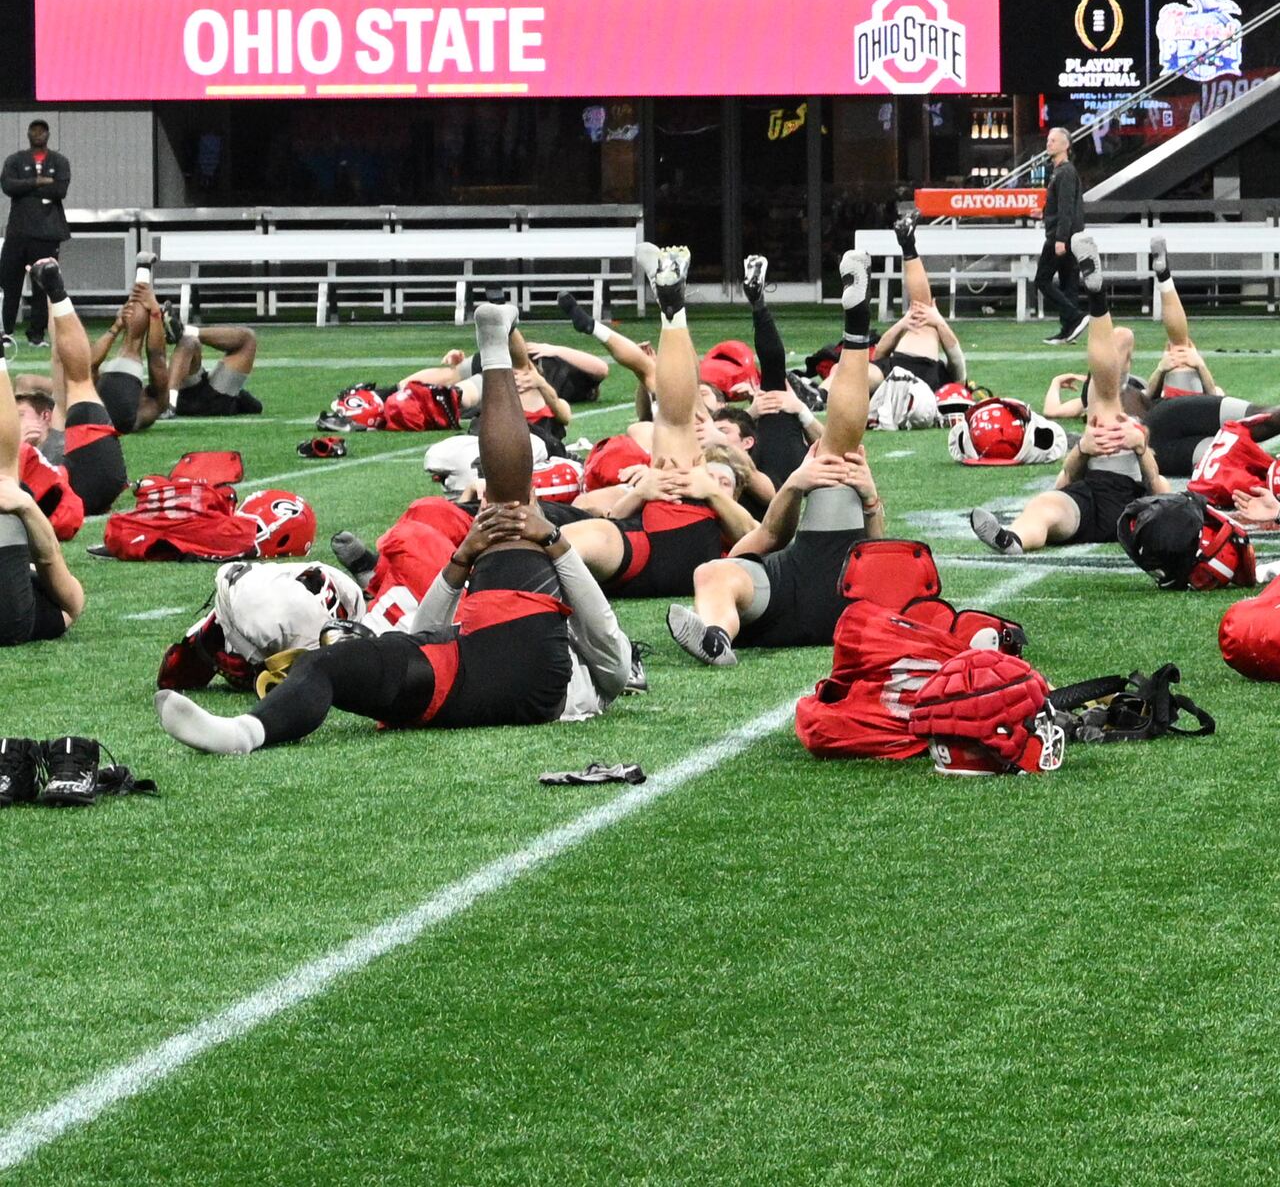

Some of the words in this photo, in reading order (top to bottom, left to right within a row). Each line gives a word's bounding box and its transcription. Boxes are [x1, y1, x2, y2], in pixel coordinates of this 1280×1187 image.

[184, 8, 343, 76] OHIO
[355, 7, 547, 75] STATE
[857, 21, 901, 81] OHIO
[903, 15, 963, 81] STATE
[1065, 57, 1135, 72] PLAYOFF
[1058, 72, 1142, 88] SEMIFINAL
[950, 193, 1039, 209] GATORADE
